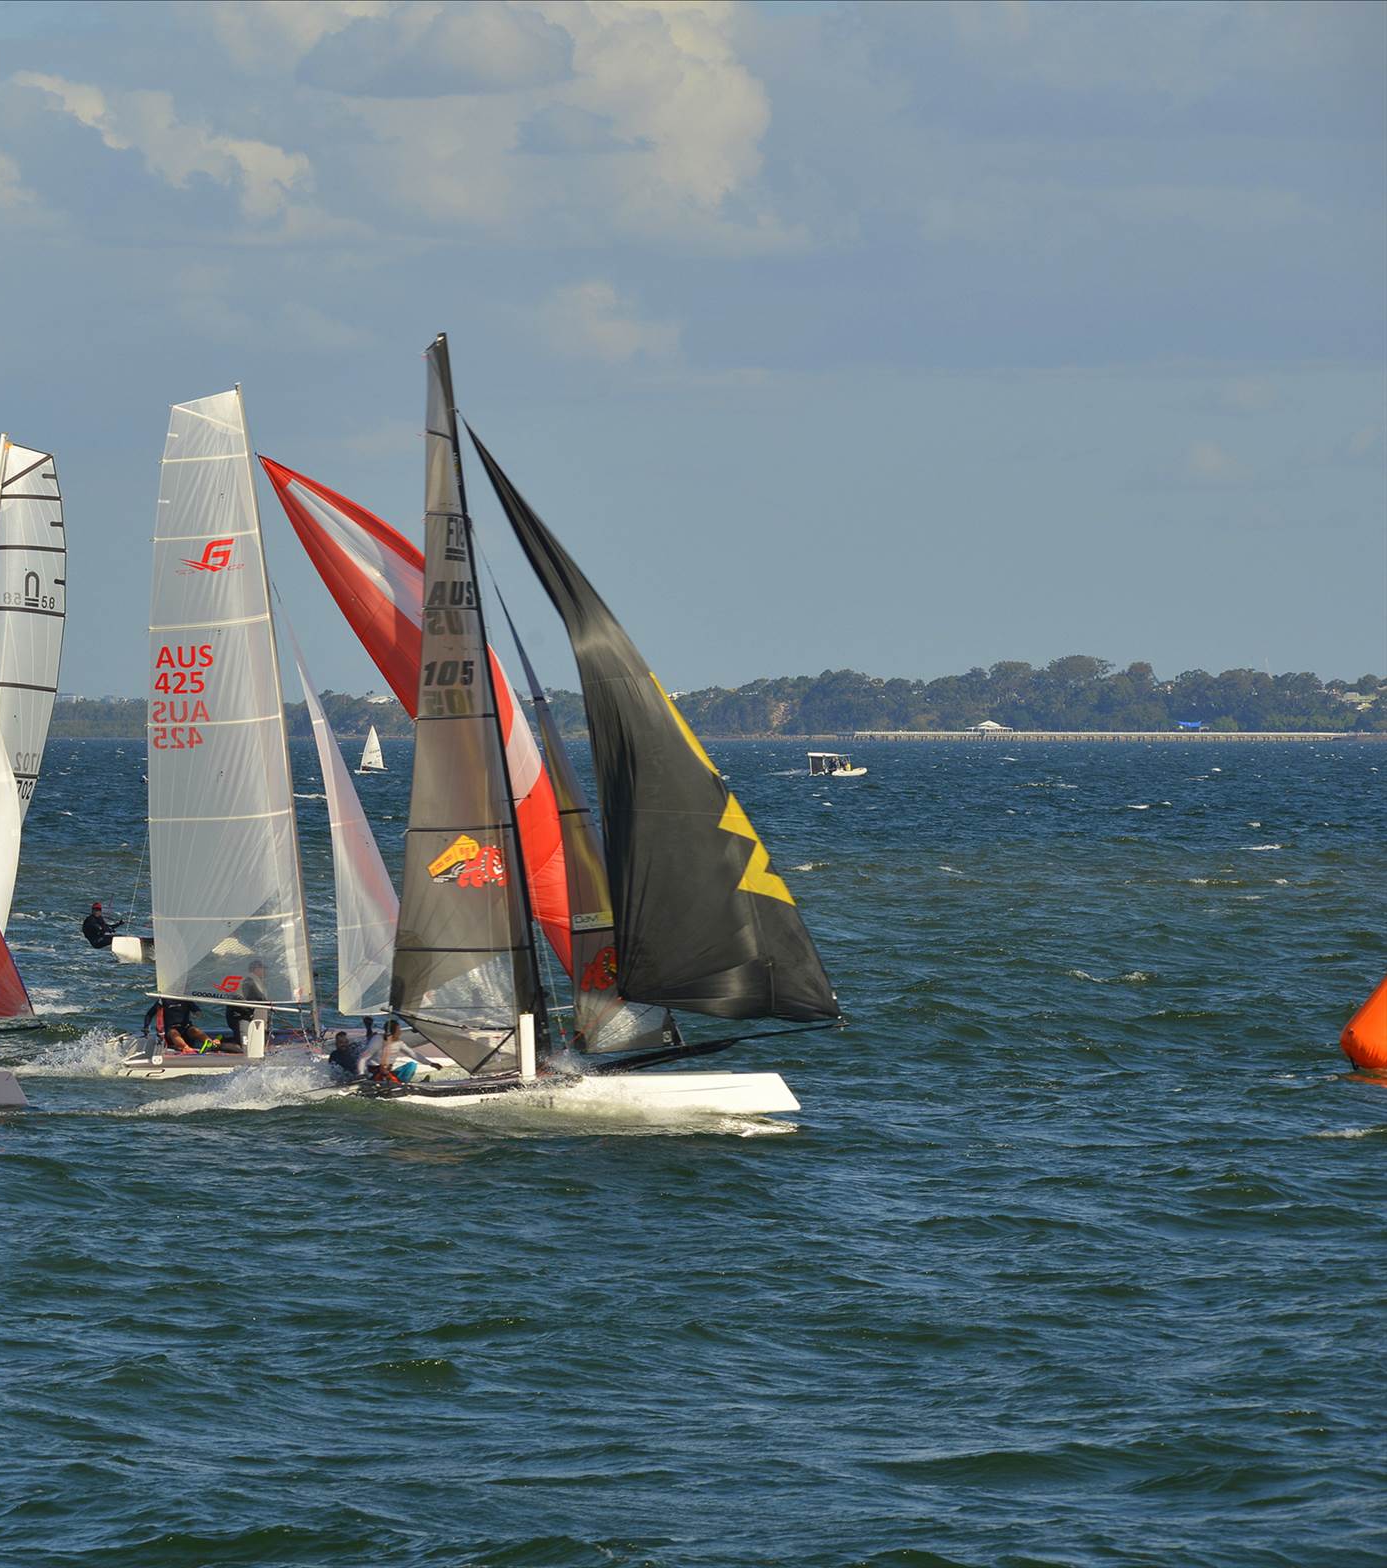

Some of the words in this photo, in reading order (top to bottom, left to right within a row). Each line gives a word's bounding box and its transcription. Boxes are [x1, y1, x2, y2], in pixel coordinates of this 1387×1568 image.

[427, 581, 474, 606] AUS
[155, 645, 214, 669] AUS
[154, 671, 205, 695] 425
[423, 660, 475, 687] 105
